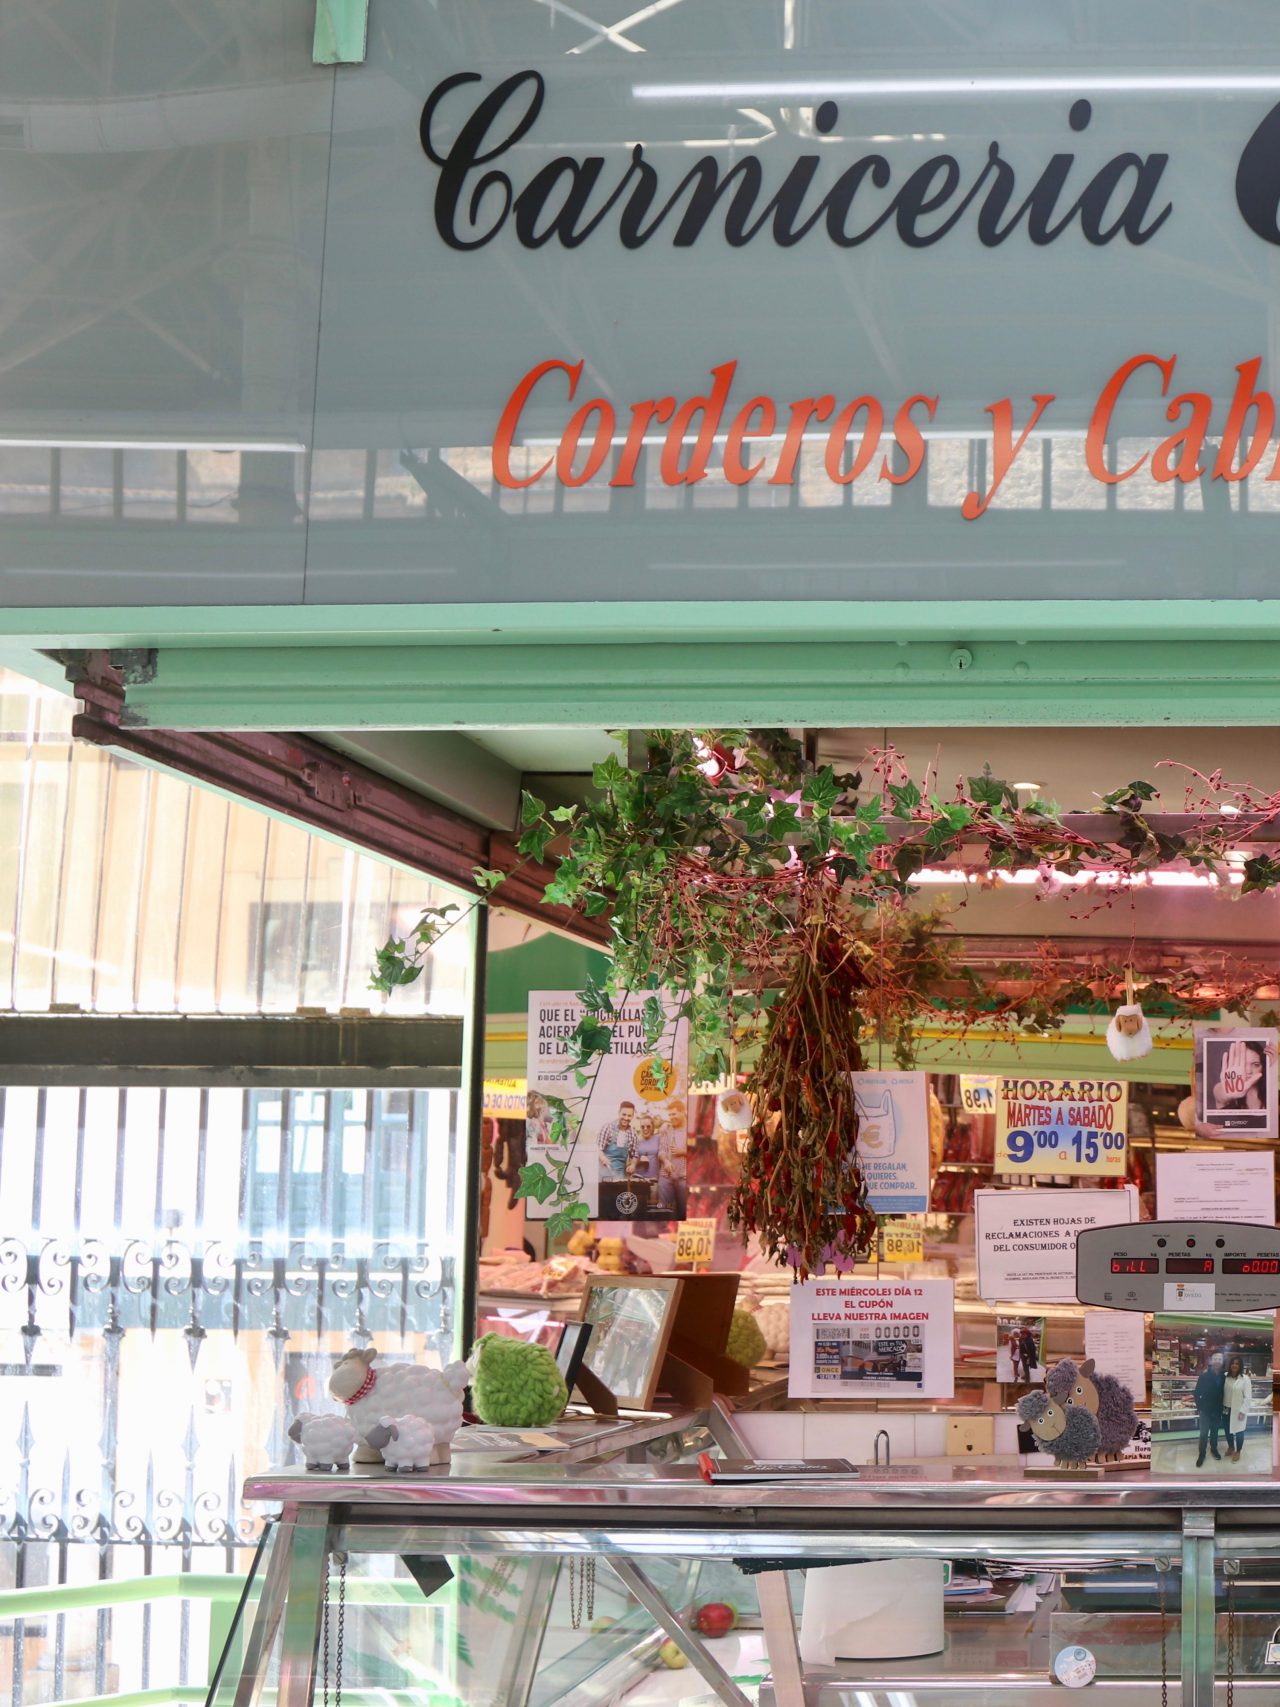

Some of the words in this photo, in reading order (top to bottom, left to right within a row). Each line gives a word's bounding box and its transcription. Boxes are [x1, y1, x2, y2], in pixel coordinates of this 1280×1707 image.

[418, 69, 1173, 251] Carniceria
[491, 358, 940, 489] Corderos
[961, 393, 1057, 521] y
[539, 1009, 561, 1023] QUE
[564, 1009, 577, 1022] EL
[539, 1042, 552, 1055] DE
[1225, 1070, 1237, 1081] NO
[1224, 1076, 1245, 1094] NO
[1001, 1080, 1123, 1103] HORARIO
[1007, 1101, 1051, 1129] MARTES
[1055, 1107, 1064, 1126] A
[1068, 1103, 1114, 1131] SABADO
[1058, 1151, 1067, 1161] a
[1105, 1154, 1121, 1163] horas
[1013, 1218, 1051, 1227] EXISTEN
[1053, 1217, 1082, 1226] HOJAS
[1084, 1216, 1096, 1225] DE
[985, 1230, 1060, 1240] RECLAMACIONES
[993, 1244, 1011, 1252] DEL
[1012, 1242, 1068, 1252] CONSUMIDOR
[815, 1288, 837, 1297] ESTE
[839, 1286, 892, 1297] MIÉRCOLES
[894, 1287, 911, 1297] DÍA
[913, 1289, 924, 1297] 12
[844, 1301, 856, 1309] EL
[858, 1299, 894, 1309] CUPÓN
[811, 1312, 842, 1321] LLEVA
[844, 1312, 888, 1321] NUESTRA
[889, 1312, 929, 1321] IMAGEN
